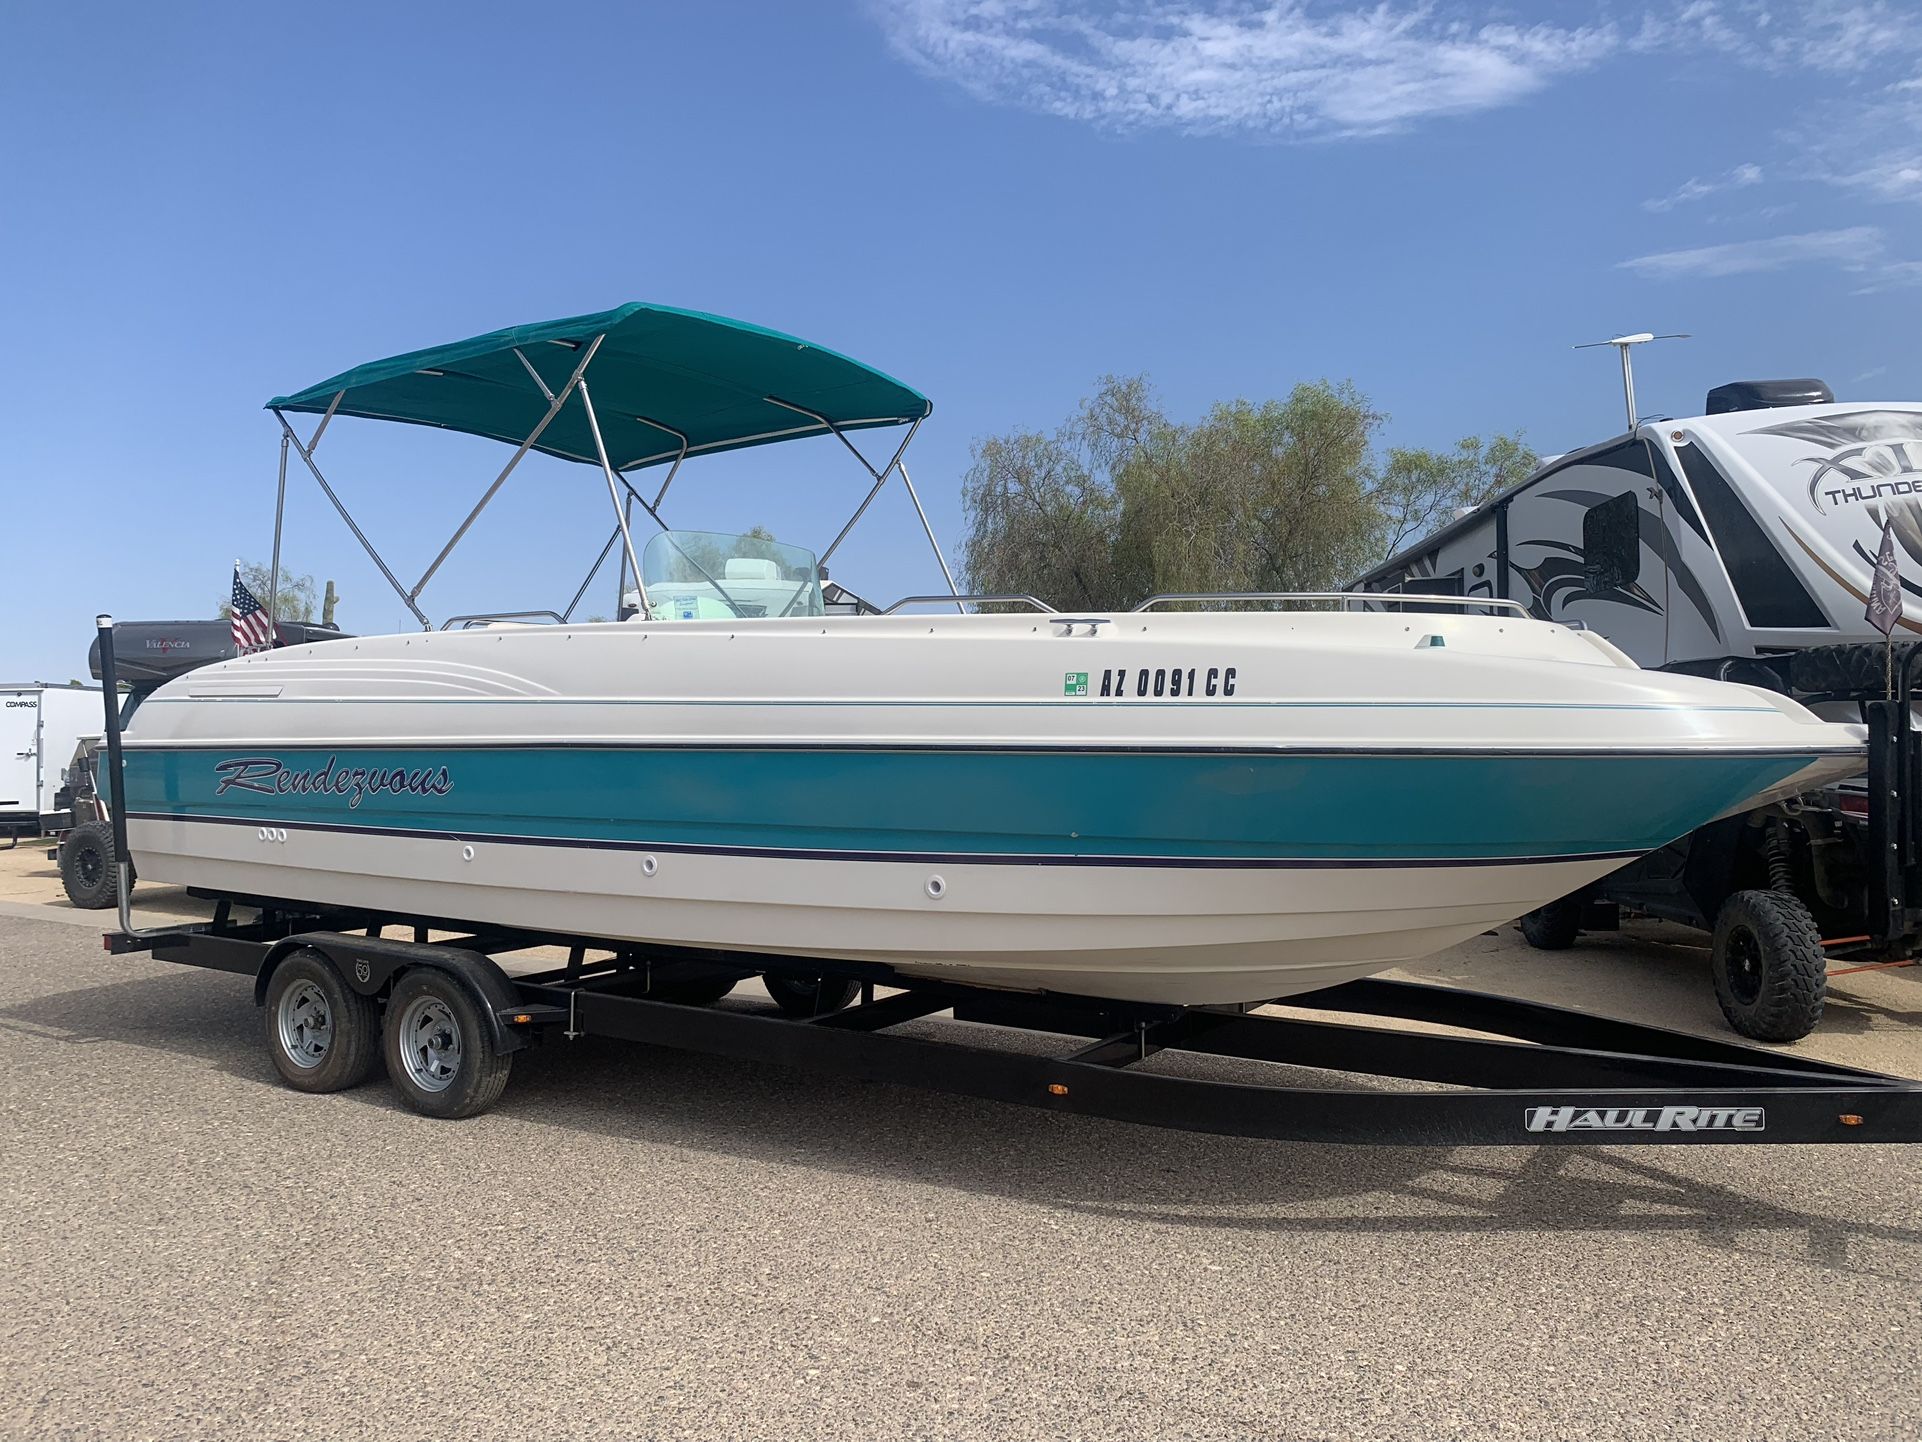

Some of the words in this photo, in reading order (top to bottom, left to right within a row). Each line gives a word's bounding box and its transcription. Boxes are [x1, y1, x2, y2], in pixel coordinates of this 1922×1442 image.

[1100, 669, 1126, 697] AZ
[1137, 668, 1196, 697] 0091
[1205, 667, 1237, 697] CC
[215, 754, 454, 809] Rendezvous
